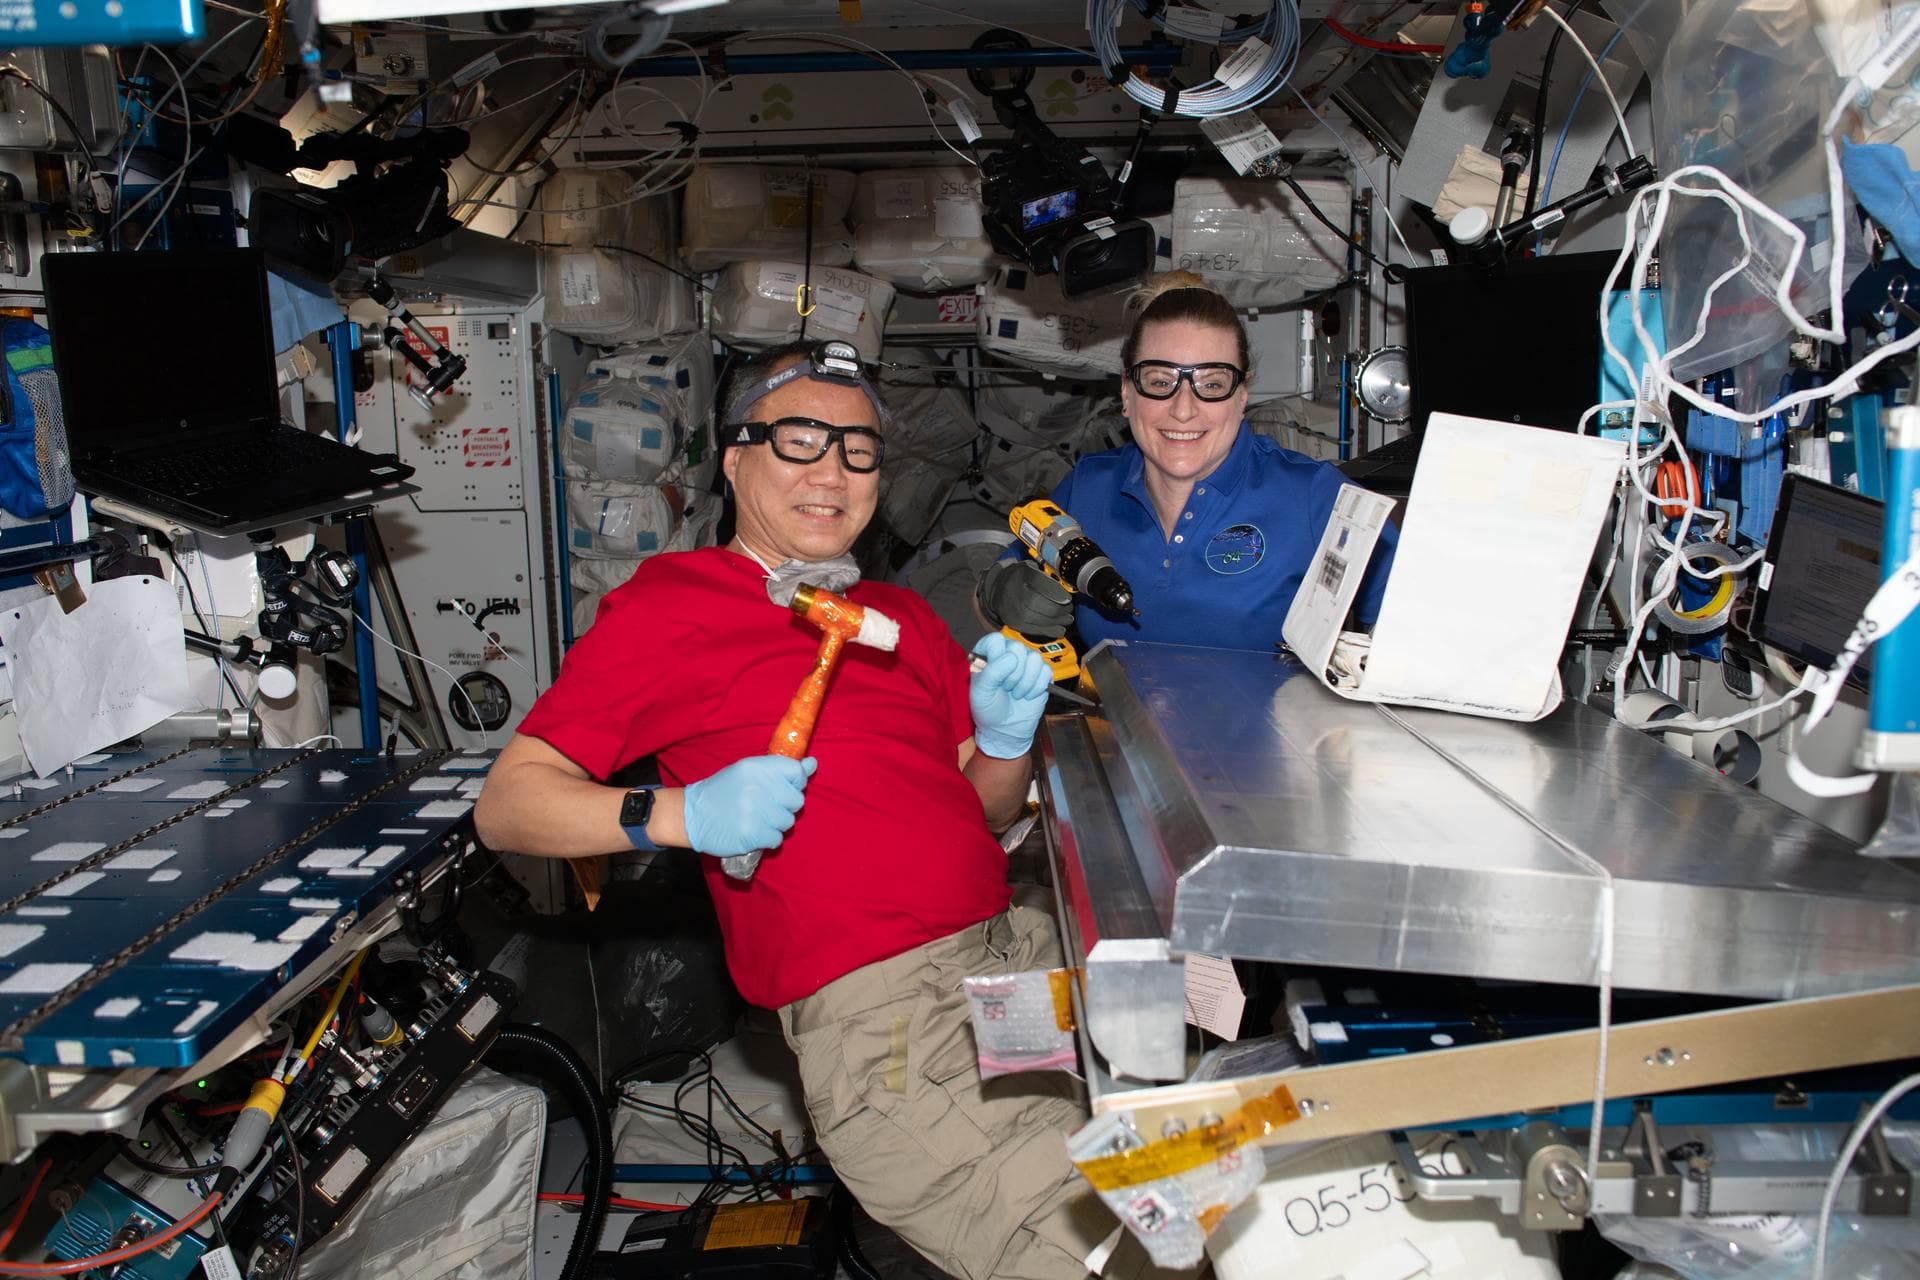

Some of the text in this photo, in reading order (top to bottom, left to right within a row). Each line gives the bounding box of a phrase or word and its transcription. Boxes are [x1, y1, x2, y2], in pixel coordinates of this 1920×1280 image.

[941, 181, 981, 195] 0-5155
[945, 298, 974, 314] EXIT
[453, 598, 476, 616] To
